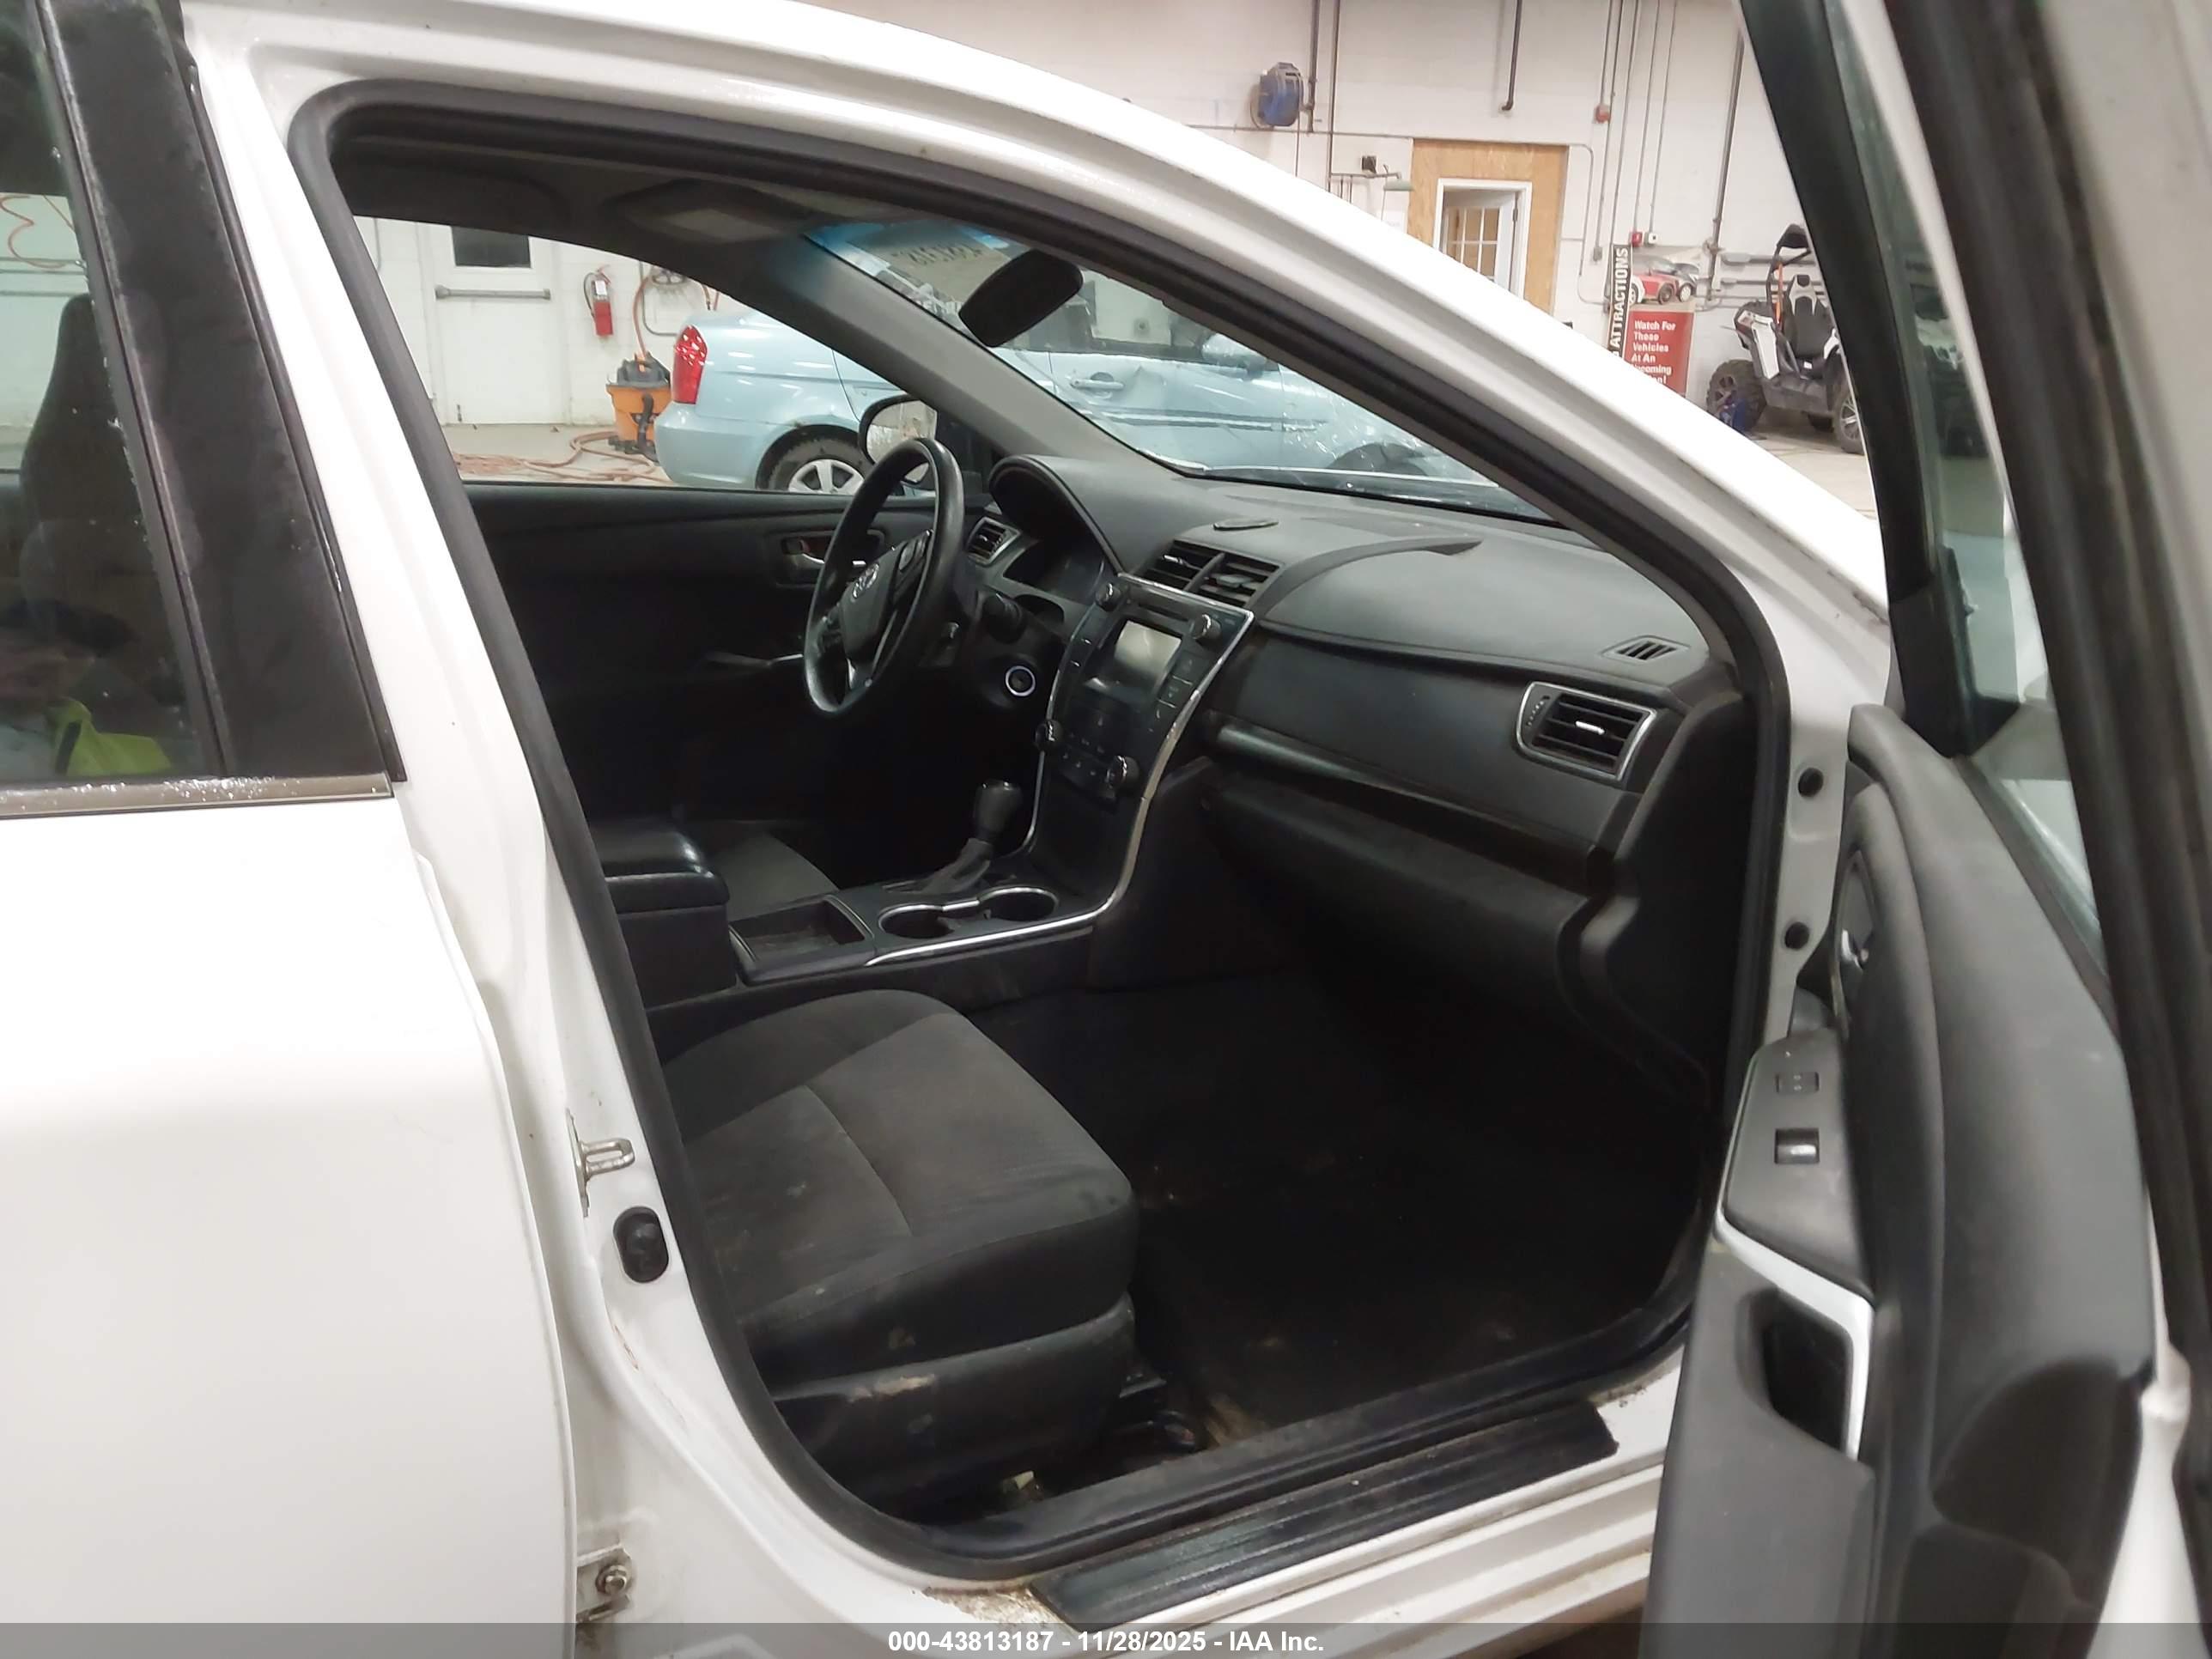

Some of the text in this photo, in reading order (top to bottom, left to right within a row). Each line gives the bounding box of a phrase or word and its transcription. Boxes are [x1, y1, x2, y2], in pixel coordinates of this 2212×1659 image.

[1610, 247, 1629, 348] ATTRACTIONS
[1634, 320, 1675, 331] Watch For
[1633, 331, 1659, 342] These
[1632, 343, 1669, 353] Vehicles
[1632, 353, 1642, 362] At
[1643, 353, 1656, 363] An
[1634, 364, 1672, 376] coming
